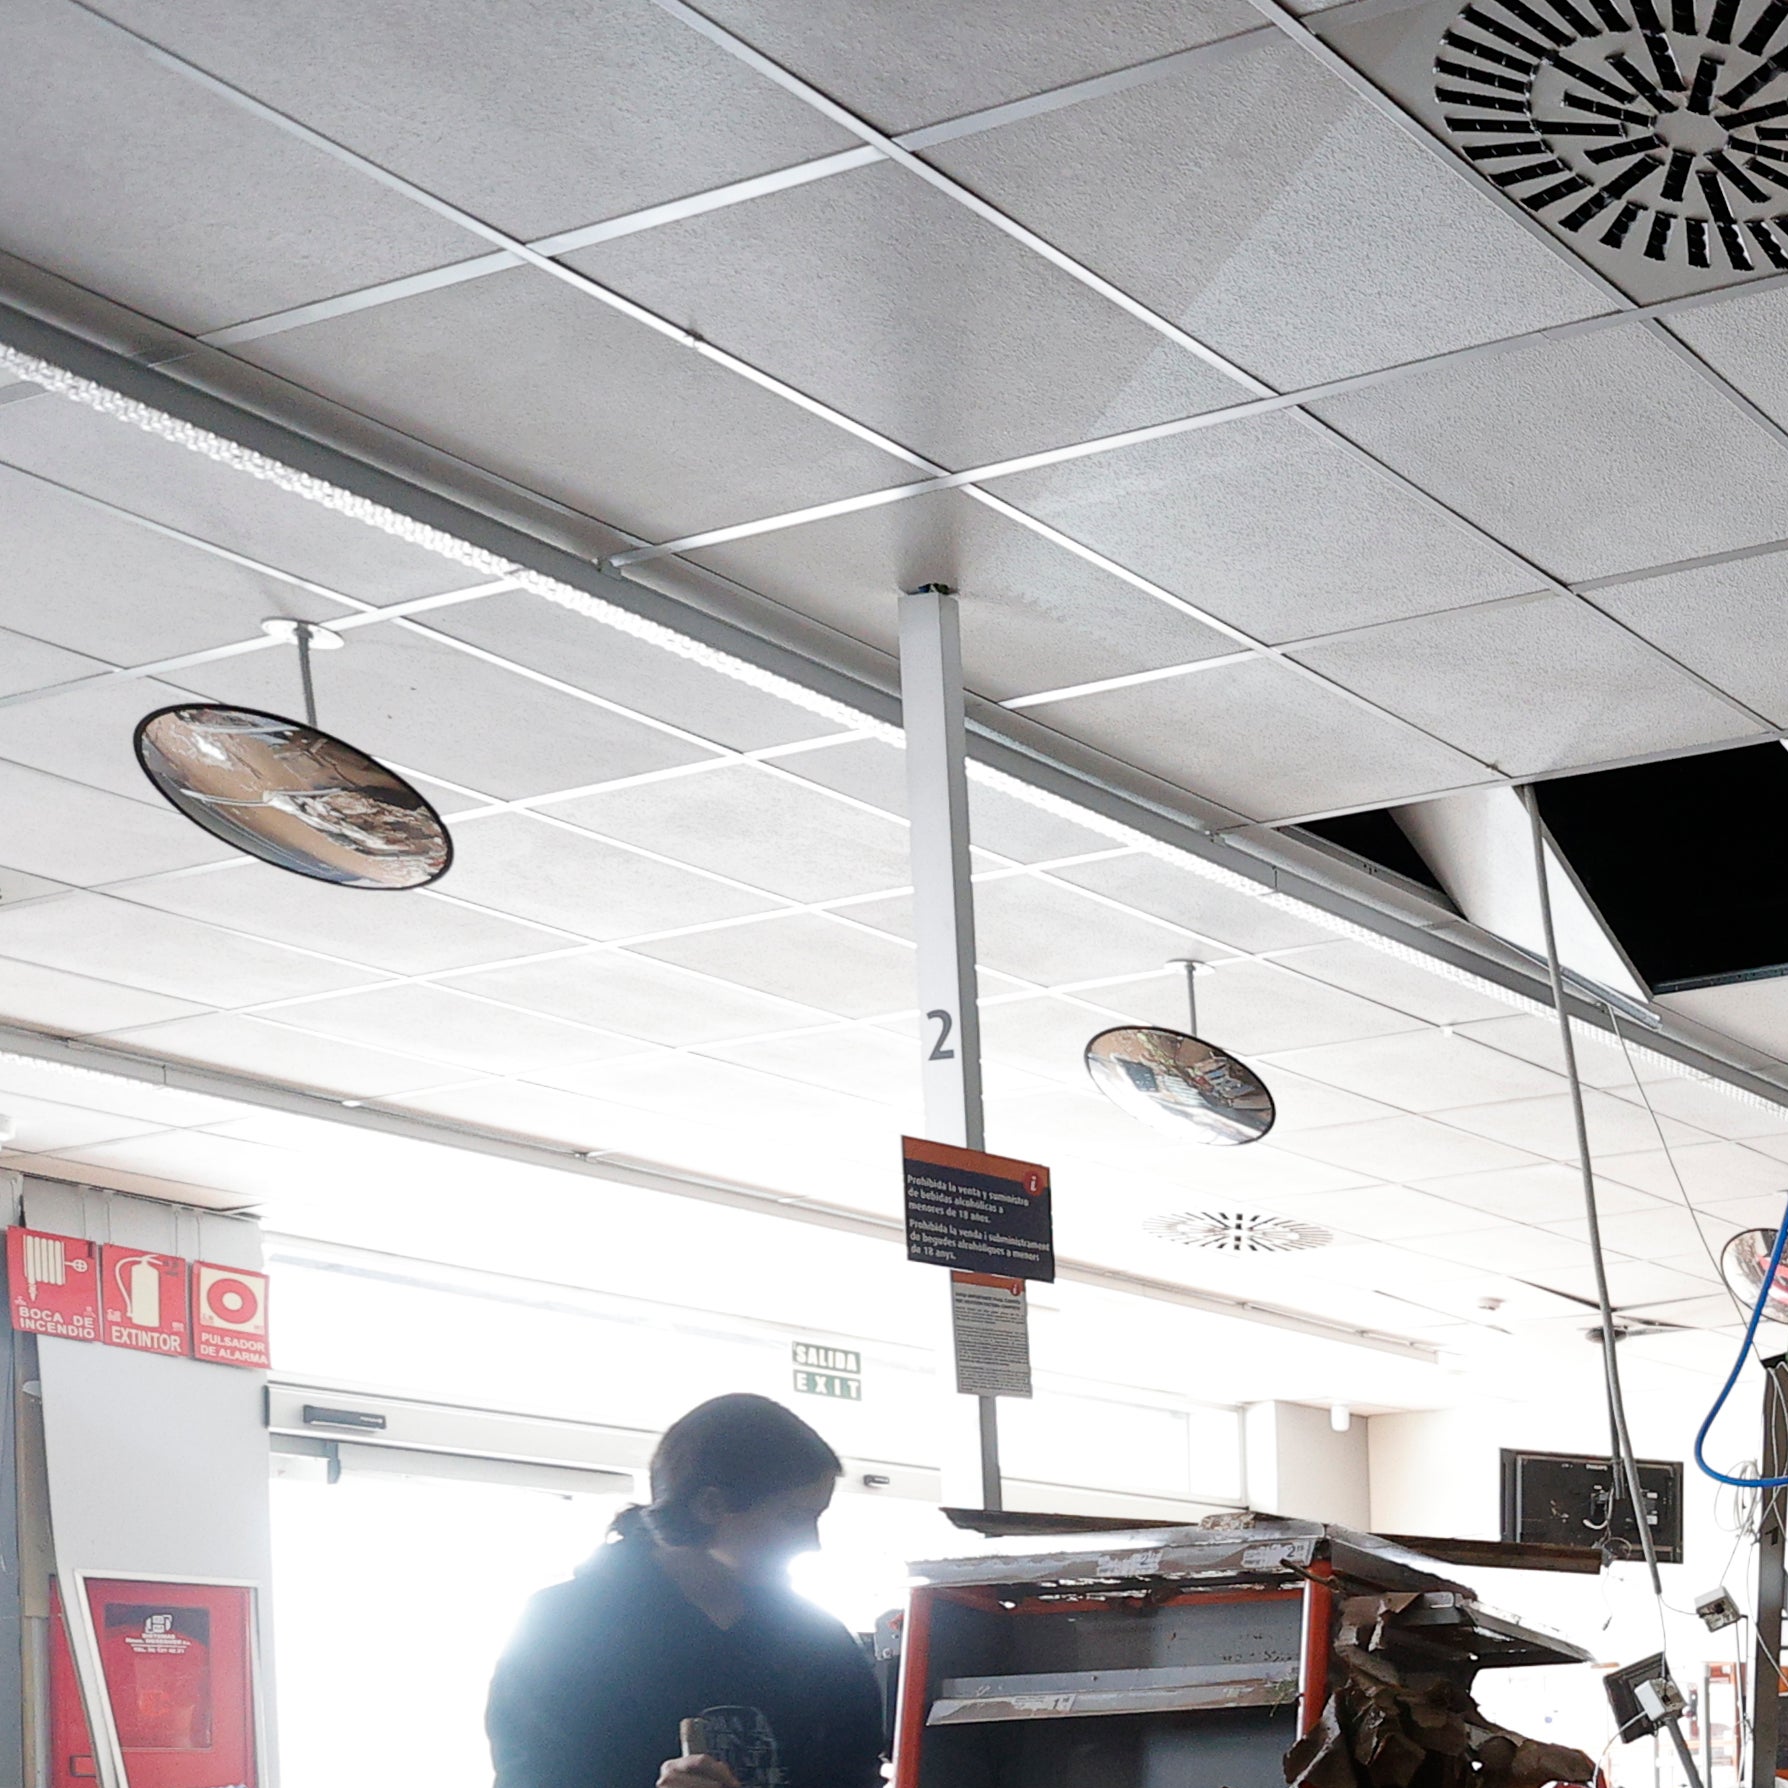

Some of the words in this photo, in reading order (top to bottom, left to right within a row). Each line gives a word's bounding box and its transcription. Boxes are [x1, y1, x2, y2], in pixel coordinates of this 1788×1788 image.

[926, 1009, 954, 1061] 2
[907, 1174, 947, 1191] Prohibida
[948, 1182, 957, 1192] la
[958, 1186, 981, 1197] venta
[988, 1192, 1029, 1207] suministro
[907, 1187, 919, 1198] de
[920, 1189, 953, 1205] bebidas
[908, 1202, 945, 1216] menores
[946, 1207, 957, 1218] de
[959, 1209, 969, 1220] 18
[909, 1218, 948, 1234] Prohibida
[949, 1224, 957, 1236] la
[958, 1228, 982, 1240] venda
[909, 1231, 920, 1241] de
[910, 1244, 921, 1254] de
[18, 1305, 64, 1324] BOCA
[73, 1313, 95, 1328] DE
[19, 1317, 96, 1339] INCENDIO
[111, 1325, 182, 1352] EXTINTOR
[201, 1332, 266, 1352] PULSADOR
[200, 1343, 218, 1357] DE
[218, 1349, 269, 1365] ALARMA
[796, 1344, 858, 1372] SALIDA
[796, 1372, 859, 1399] EXIT
